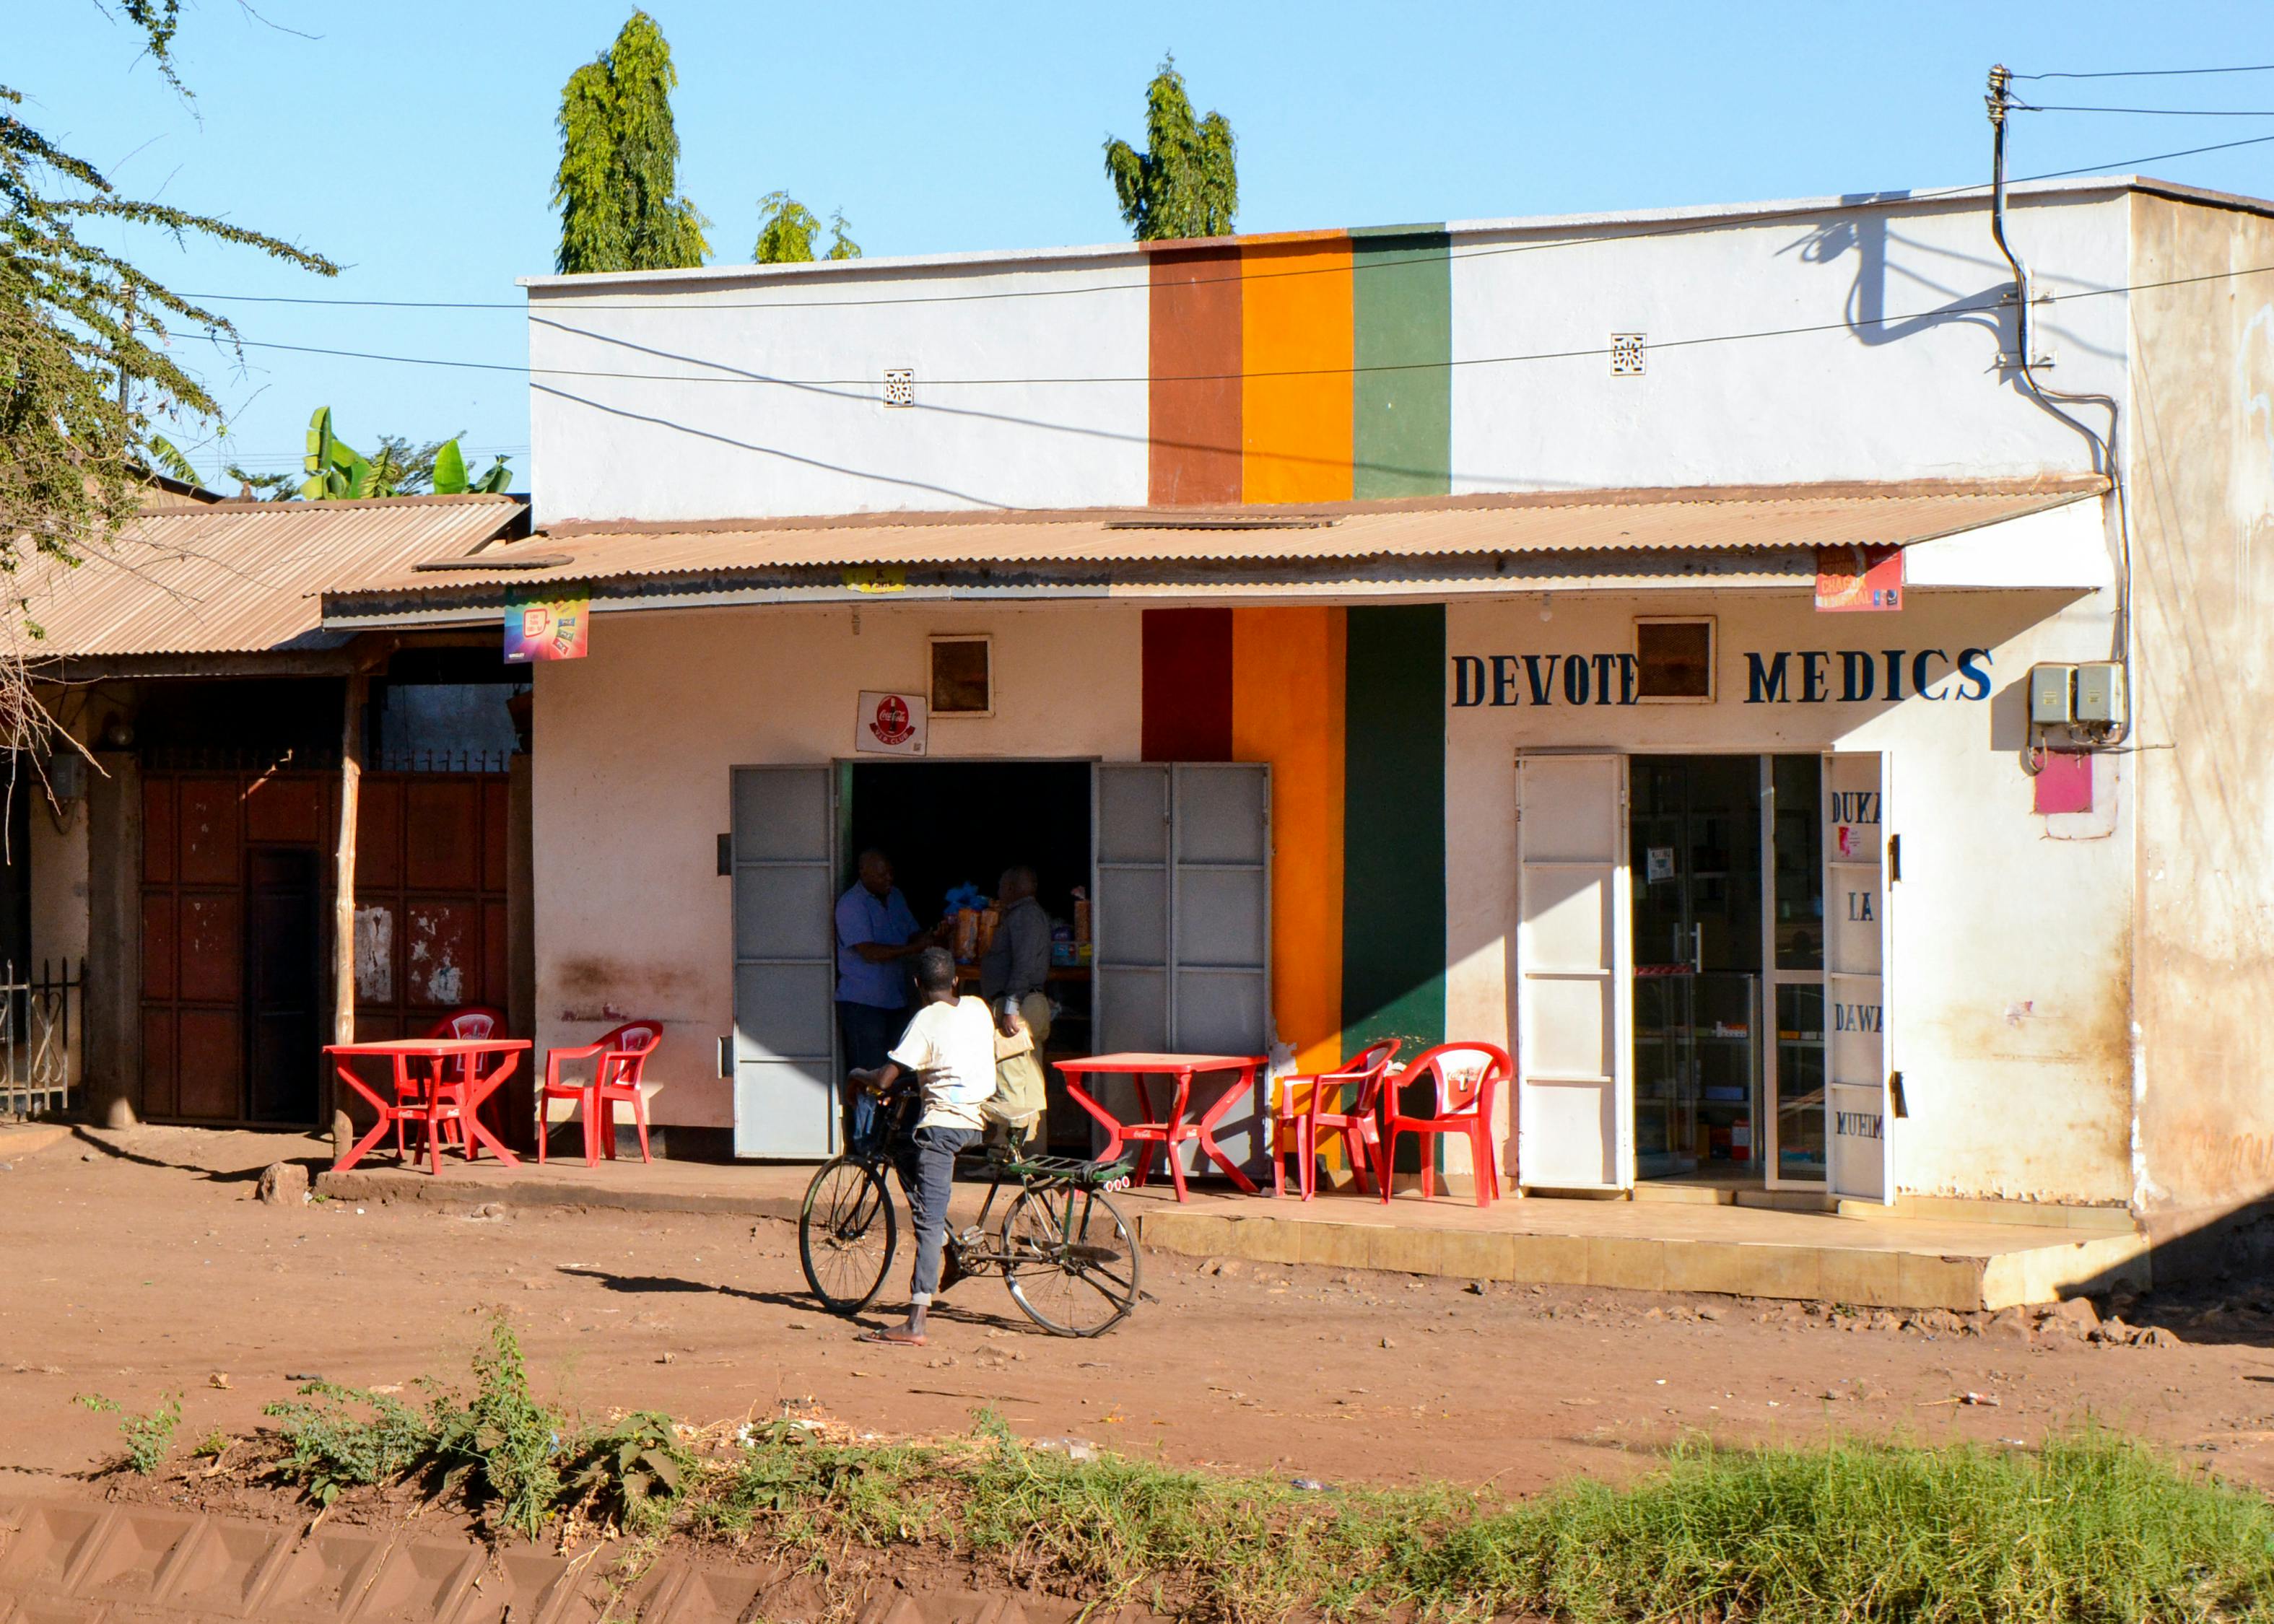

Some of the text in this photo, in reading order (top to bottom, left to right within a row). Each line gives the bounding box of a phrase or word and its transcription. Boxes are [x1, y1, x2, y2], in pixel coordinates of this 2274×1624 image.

[1451, 647, 1993, 707] DEVOTE MEDICS
[890, 732, 909, 745] CLUB
[1848, 892, 1873, 921] LA
